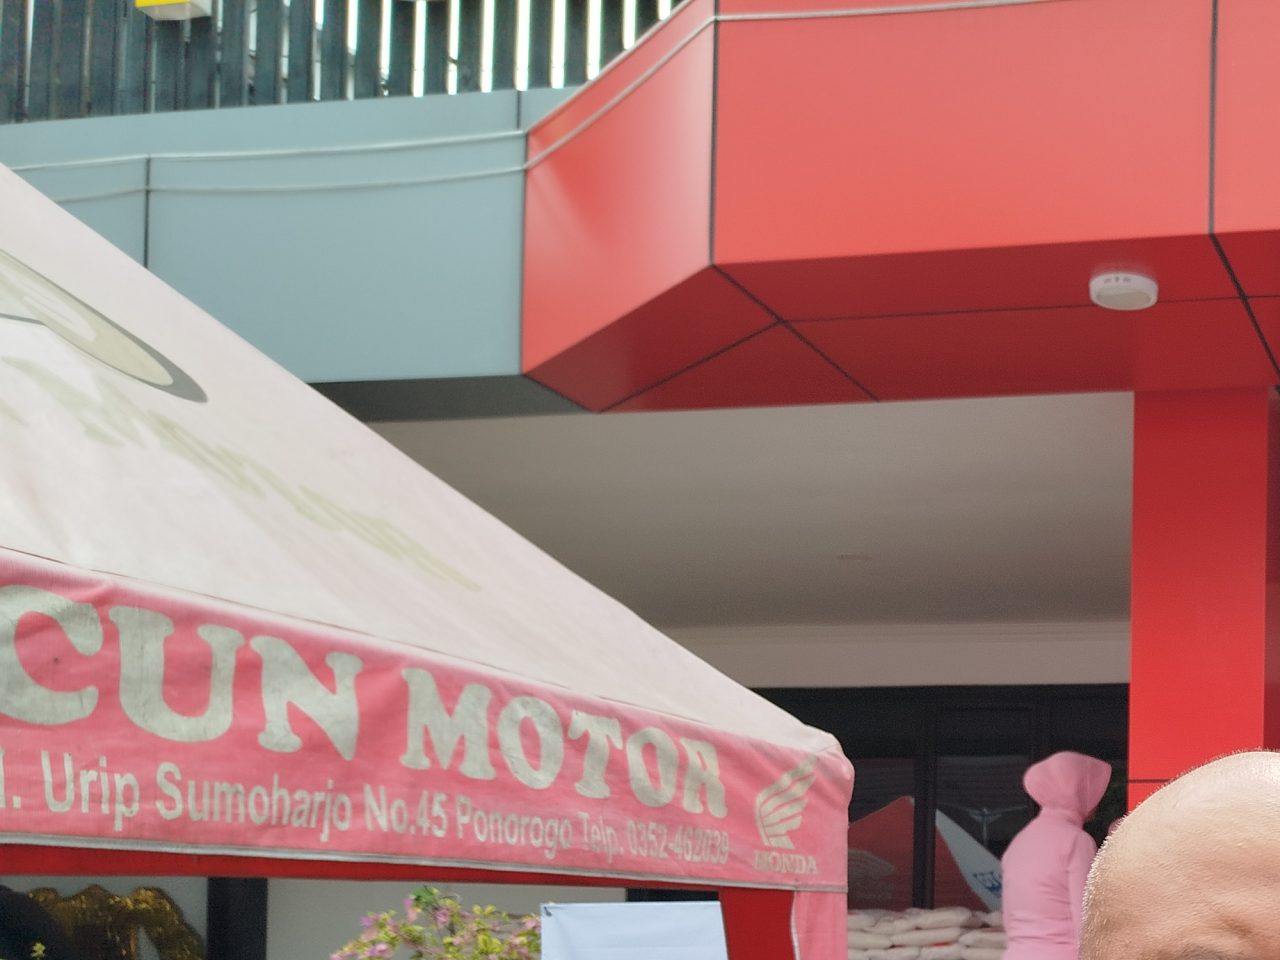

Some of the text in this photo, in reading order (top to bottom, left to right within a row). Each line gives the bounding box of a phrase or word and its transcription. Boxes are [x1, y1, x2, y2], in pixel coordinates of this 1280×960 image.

[0, 584, 728, 819] CUN MOTOR
[41, 750, 140, 832] Urip
[155, 761, 352, 842] Sumoharjo
[455, 794, 573, 860] Ponorogo
[754, 852, 819, 875] HONDA
